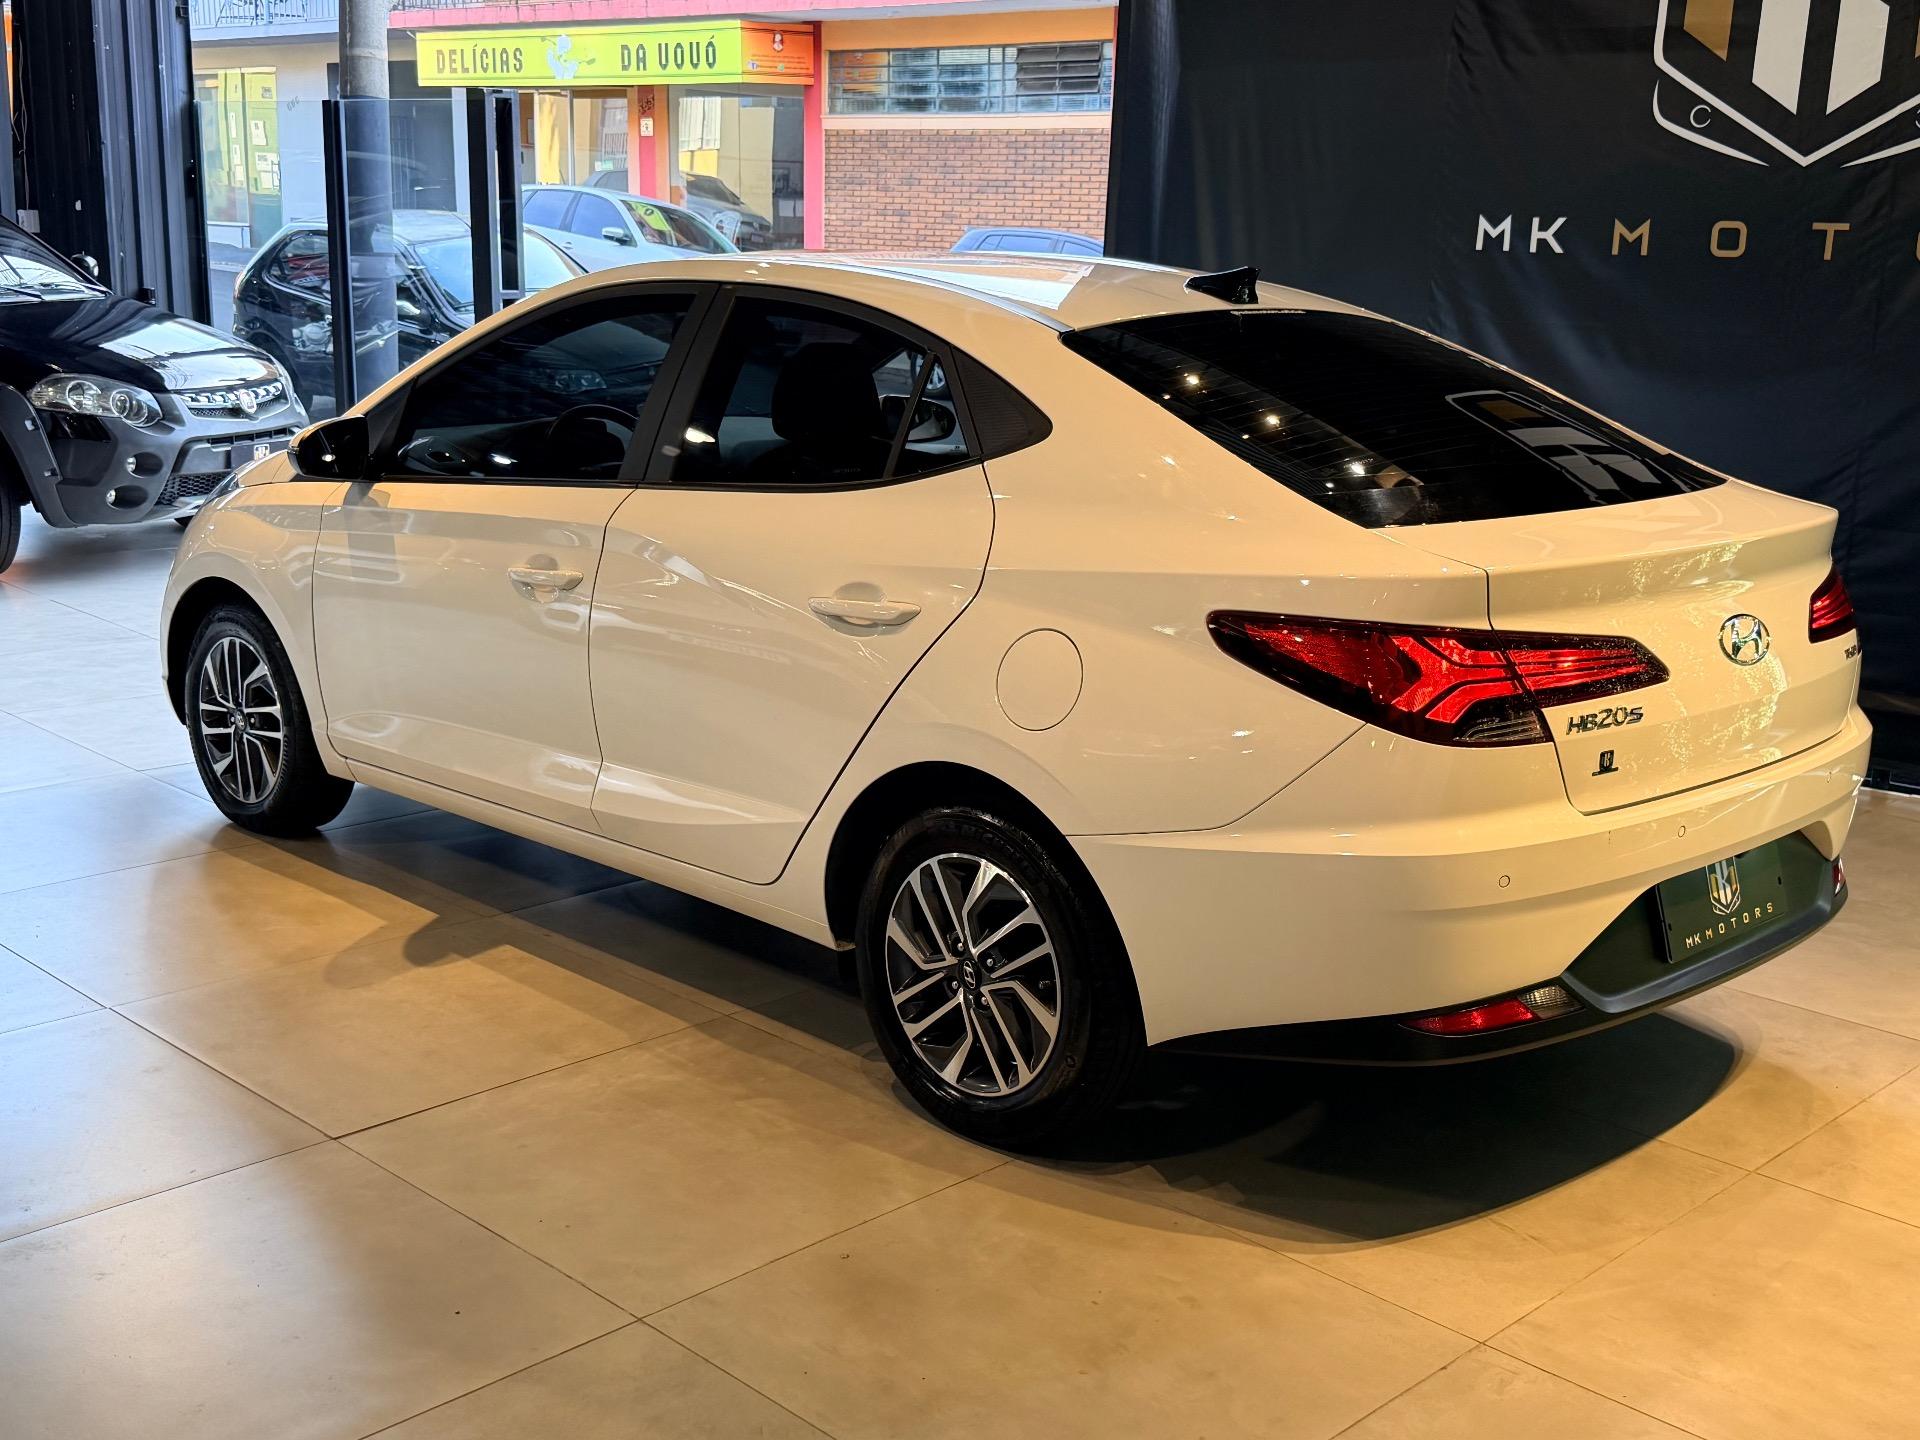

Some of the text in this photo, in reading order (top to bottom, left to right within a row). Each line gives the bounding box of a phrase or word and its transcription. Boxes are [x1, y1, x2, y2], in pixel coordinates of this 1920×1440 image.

[436, 43, 523, 74] DELÍCIAS
[620, 43, 647, 72] DA
[1475, 213, 1920, 264] MK MOT
[1685, 902, 1773, 949] MK MOTORS
